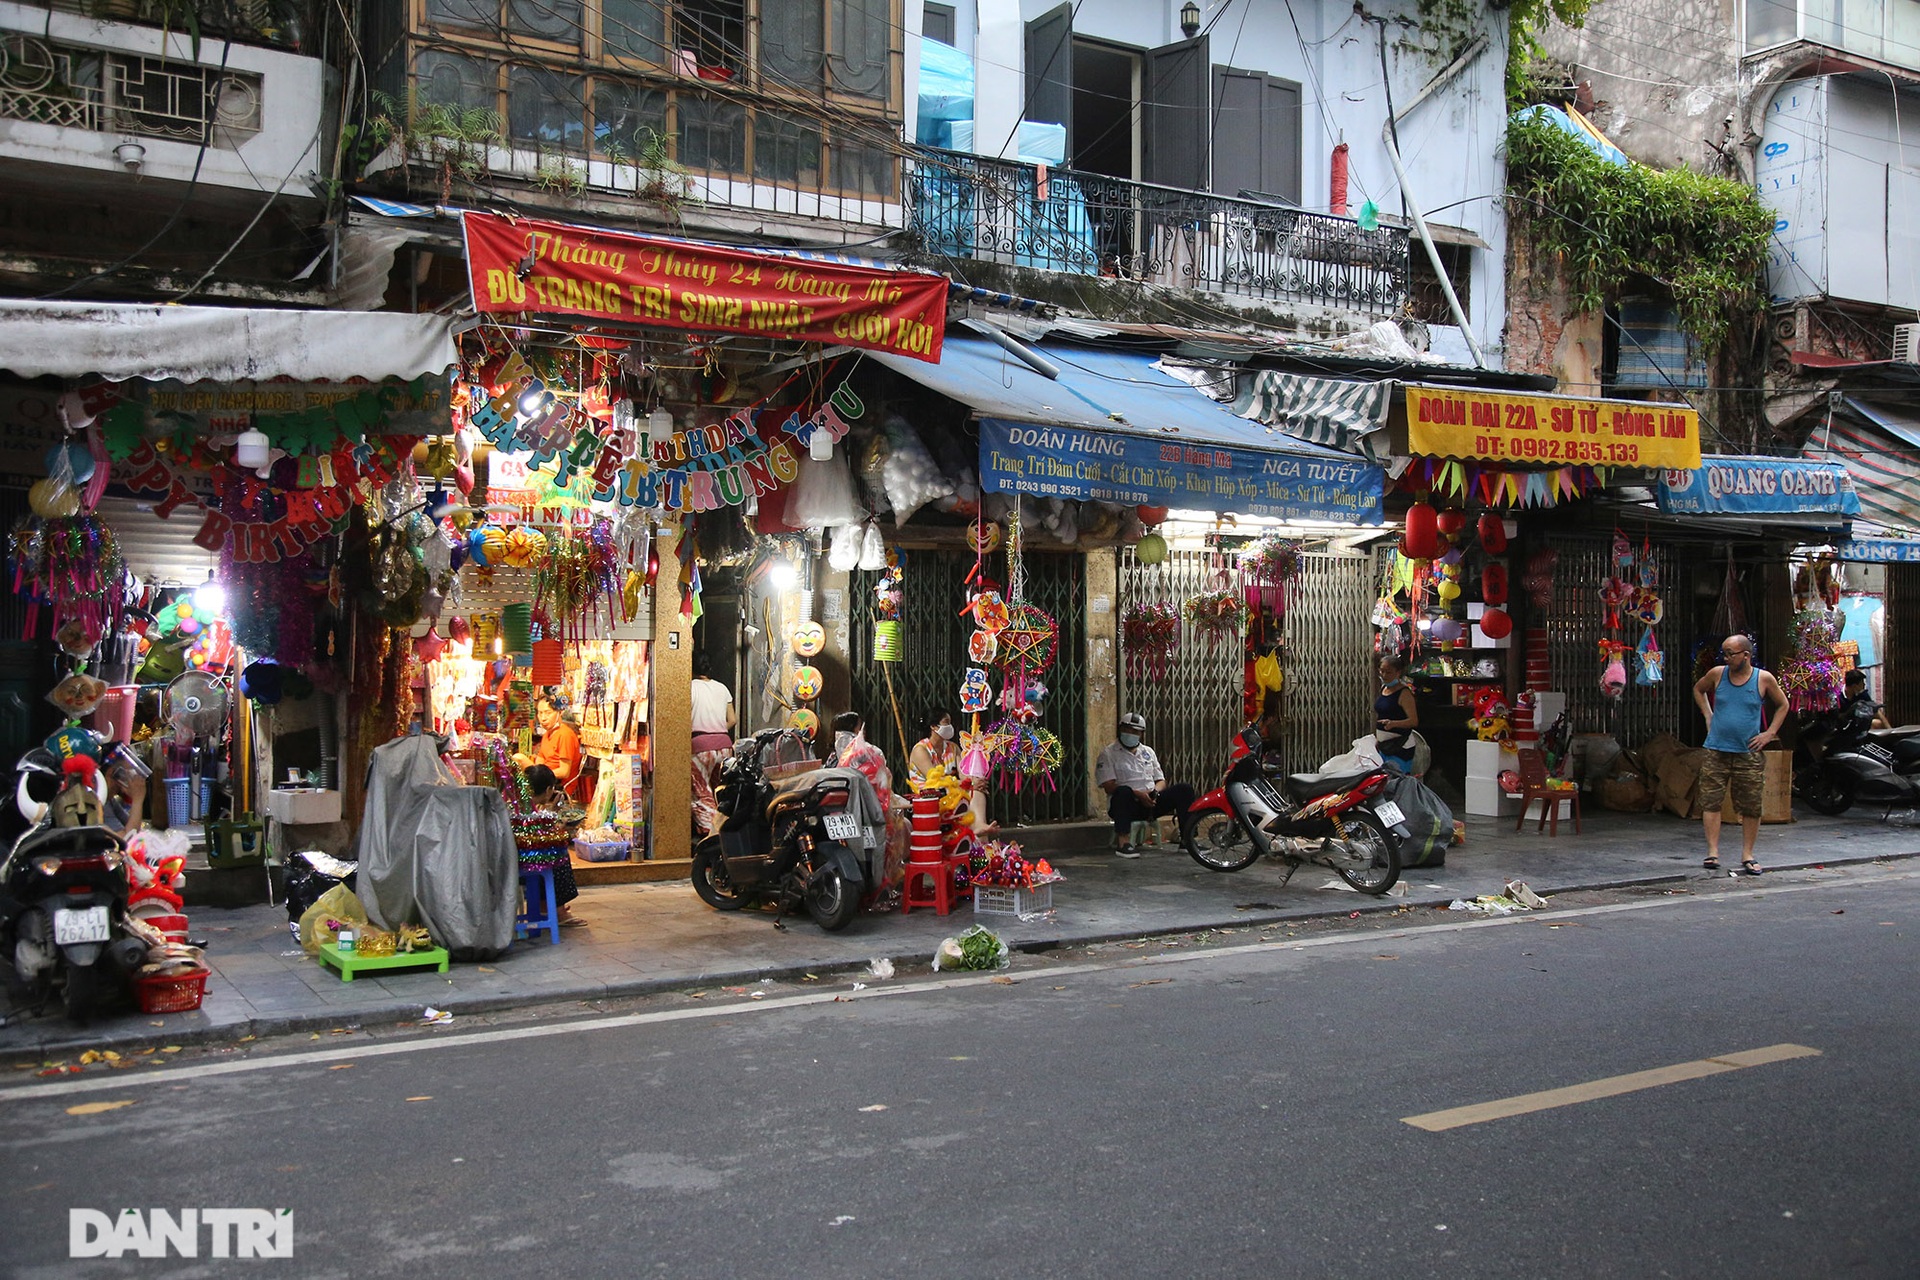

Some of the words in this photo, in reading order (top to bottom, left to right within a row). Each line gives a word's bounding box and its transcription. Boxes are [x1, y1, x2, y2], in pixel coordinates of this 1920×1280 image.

[523, 232, 628, 275] Thắng
[638, 245, 719, 287] Thủy
[728, 262, 762, 286] 24
[774, 265, 853, 303] Hàng
[859, 278, 904, 306] Mã
[487, 261, 527, 304] ĐỒ
[531, 276, 622, 314] TRANG
[629, 283, 672, 319] TRÍ
[680, 291, 743, 328] SINH
[749, 299, 815, 339] NHẬT
[833, 309, 891, 345] CƯỚI
[895, 312, 933, 355] HỎI
[617, 408, 759, 462] BIRTHDAY
[1418, 395, 1466, 426] DOÃN
[1471, 402, 1500, 433] ĐẠI
[1504, 403, 1538, 430] 22A
[1550, 404, 1576, 432] SƯ
[1578, 403, 1599, 434] TỬ
[1660, 410, 1686, 439] LÂN
[1008, 427, 1066, 449] DOÃN
[1069, 434, 1126, 456] HƯNG
[1159, 444, 1182, 463] 22B
[1184, 450, 1212, 469] Hàng
[1476, 436, 1504, 456] ĐT:
[1510, 438, 1639, 463] 0982.835.133
[990, 451, 1024, 478] Trang
[1027, 455, 1046, 476] Trí
[1047, 457, 1073, 478] Đám
[1075, 460, 1102, 481] Cưới
[1110, 461, 1129, 485] Cắt
[1131, 465, 1154, 487] Chữ
[1157, 466, 1177, 494] Xốp
[1186, 472, 1213, 494] Khay
[1215, 475, 1236, 501] Hộp
[1238, 475, 1257, 502] Xốp
[1266, 480, 1289, 501] Mica
[1297, 484, 1310, 503] Sư
[999, 478, 1013, 490] ĐT:
[1015, 480, 1039, 493] 0243
[1040, 483, 1058, 494] 990
[1059, 485, 1081, 497] 3521
[1090, 487, 1112, 499] 0918
[1114, 489, 1130, 500] 118
[1262, 459, 1300, 478] NGA
[1307, 462, 1360, 483] TUYẾT
[1707, 465, 1777, 500] QUANG
[1780, 468, 1837, 496] OANH
[829, 826, 858, 838] 341.07
[60, 925, 106, 942] 262.17
